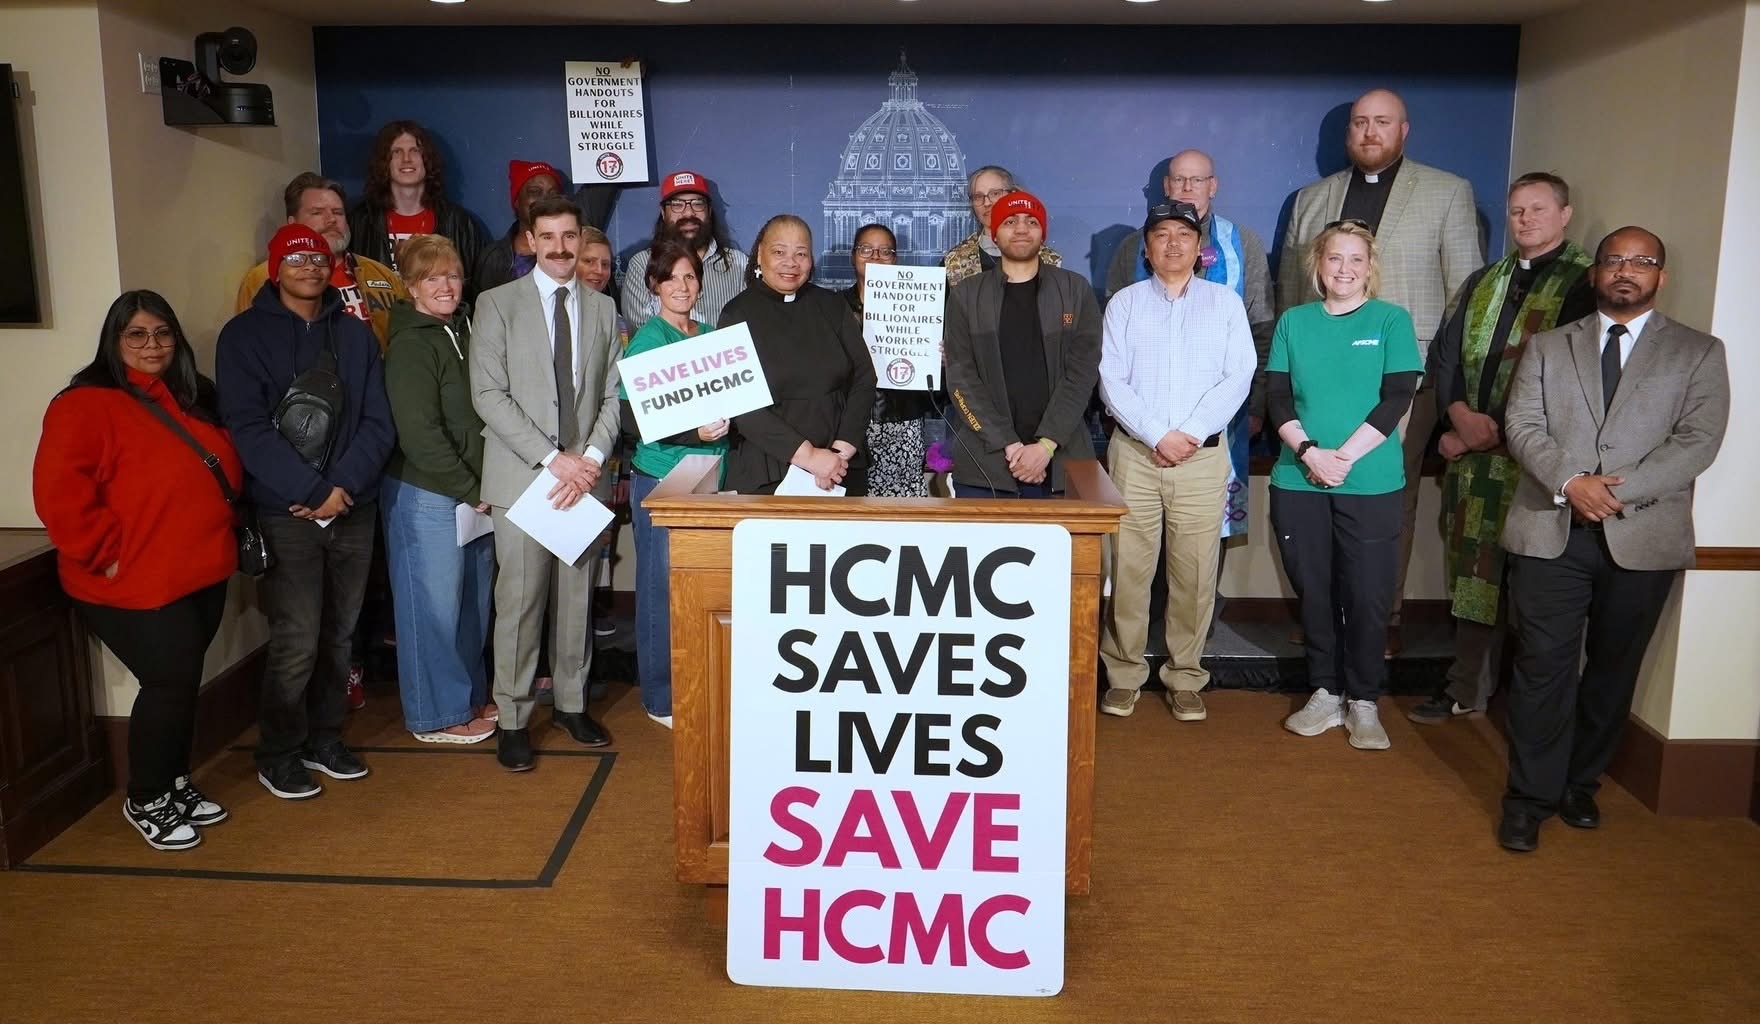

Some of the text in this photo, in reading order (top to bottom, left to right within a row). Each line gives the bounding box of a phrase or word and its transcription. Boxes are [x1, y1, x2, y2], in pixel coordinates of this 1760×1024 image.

[595, 67, 611, 76] NO
[568, 77, 640, 86] GOVERNMENT
[575, 88, 634, 97] HANDOUTS
[594, 99, 616, 108] FOR
[569, 110, 643, 118] BILLIONAIRES
[590, 121, 623, 129] WHILE
[581, 131, 634, 140] WORKERS
[578, 142, 635, 151] STRUGGLE
[601, 160, 618, 173] 17
[897, 271, 914, 280] NO
[866, 279, 944, 291] GOVERNMENT
[873, 291, 936, 302] HANDOUTS
[892, 303, 915, 312] FOR
[865, 312, 943, 324] BILLIONAIRES
[885, 325, 920, 334] WHILE
[875, 335, 930, 345] WORKERS
[633, 345, 748, 392] SAVE LIVES
[892, 366, 909, 379] 17
[640, 369, 755, 415] FUND HCMC
[770, 543, 1036, 620] HCMC
[772, 628, 1028, 699] SAVES
[795, 710, 1004, 778] LIVES
[762, 786, 1021, 873] SAVE
[763, 888, 1032, 970] HCMC
